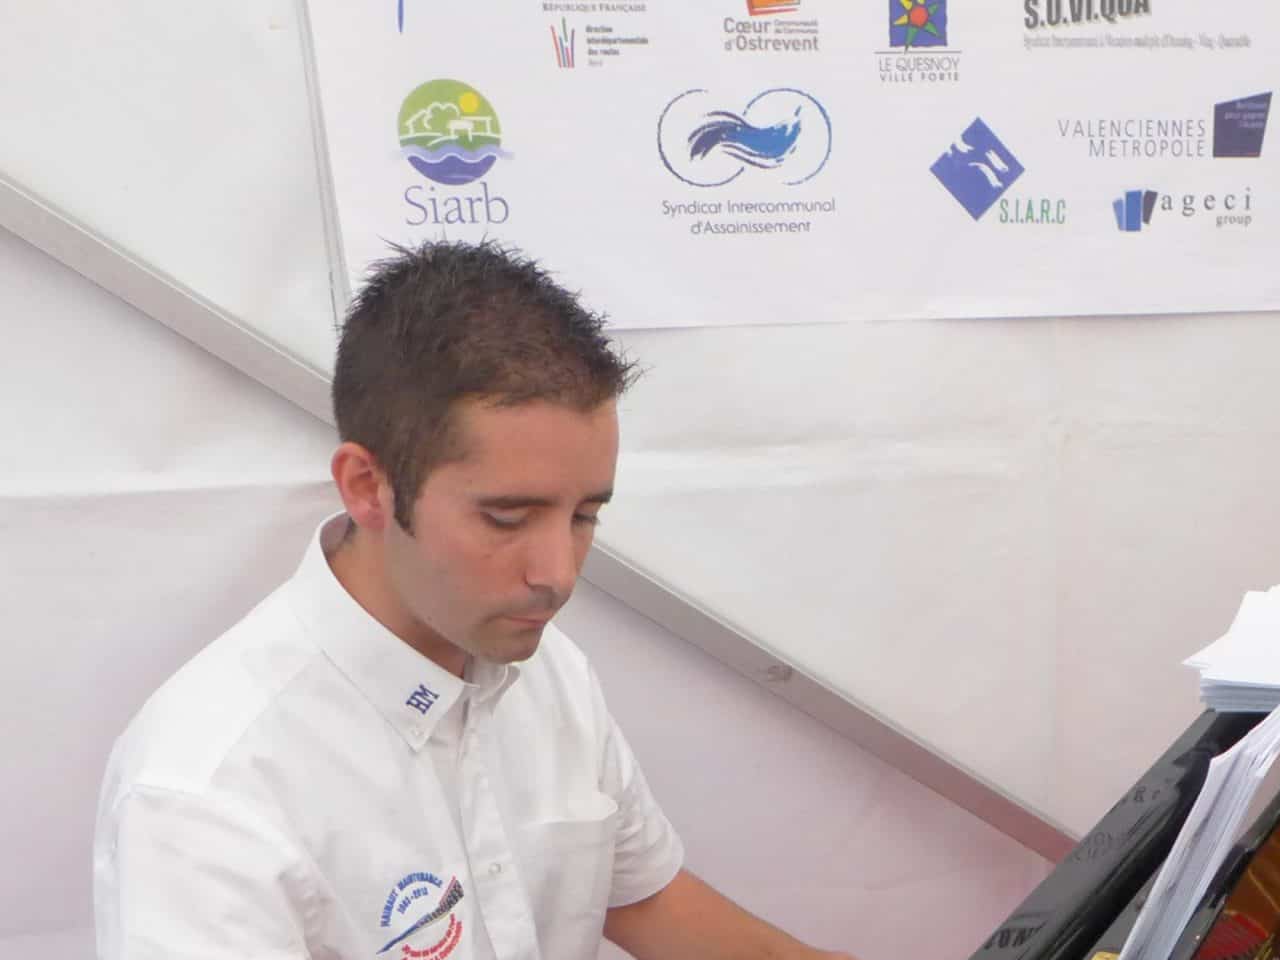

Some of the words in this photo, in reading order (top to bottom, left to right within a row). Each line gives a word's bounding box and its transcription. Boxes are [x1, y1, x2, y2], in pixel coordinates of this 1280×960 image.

[878, 57, 893, 73] LE
[895, 57, 960, 72] QUESNOY
[879, 72, 914, 83] VILLE
[920, 72, 960, 82] FORTE
[1057, 119, 1207, 138] VALENCIENNES
[1088, 139, 1206, 158] METROPOLE
[403, 181, 509, 226] Siarb
[662, 200, 722, 217] Syndicat
[727, 198, 836, 214] Intercommunal
[999, 199, 1067, 224] S.I.A.R.C
[690, 221, 811, 235] d'Assainissement
[1215, 214, 1253, 227] group
[406, 684, 440, 714] HM
